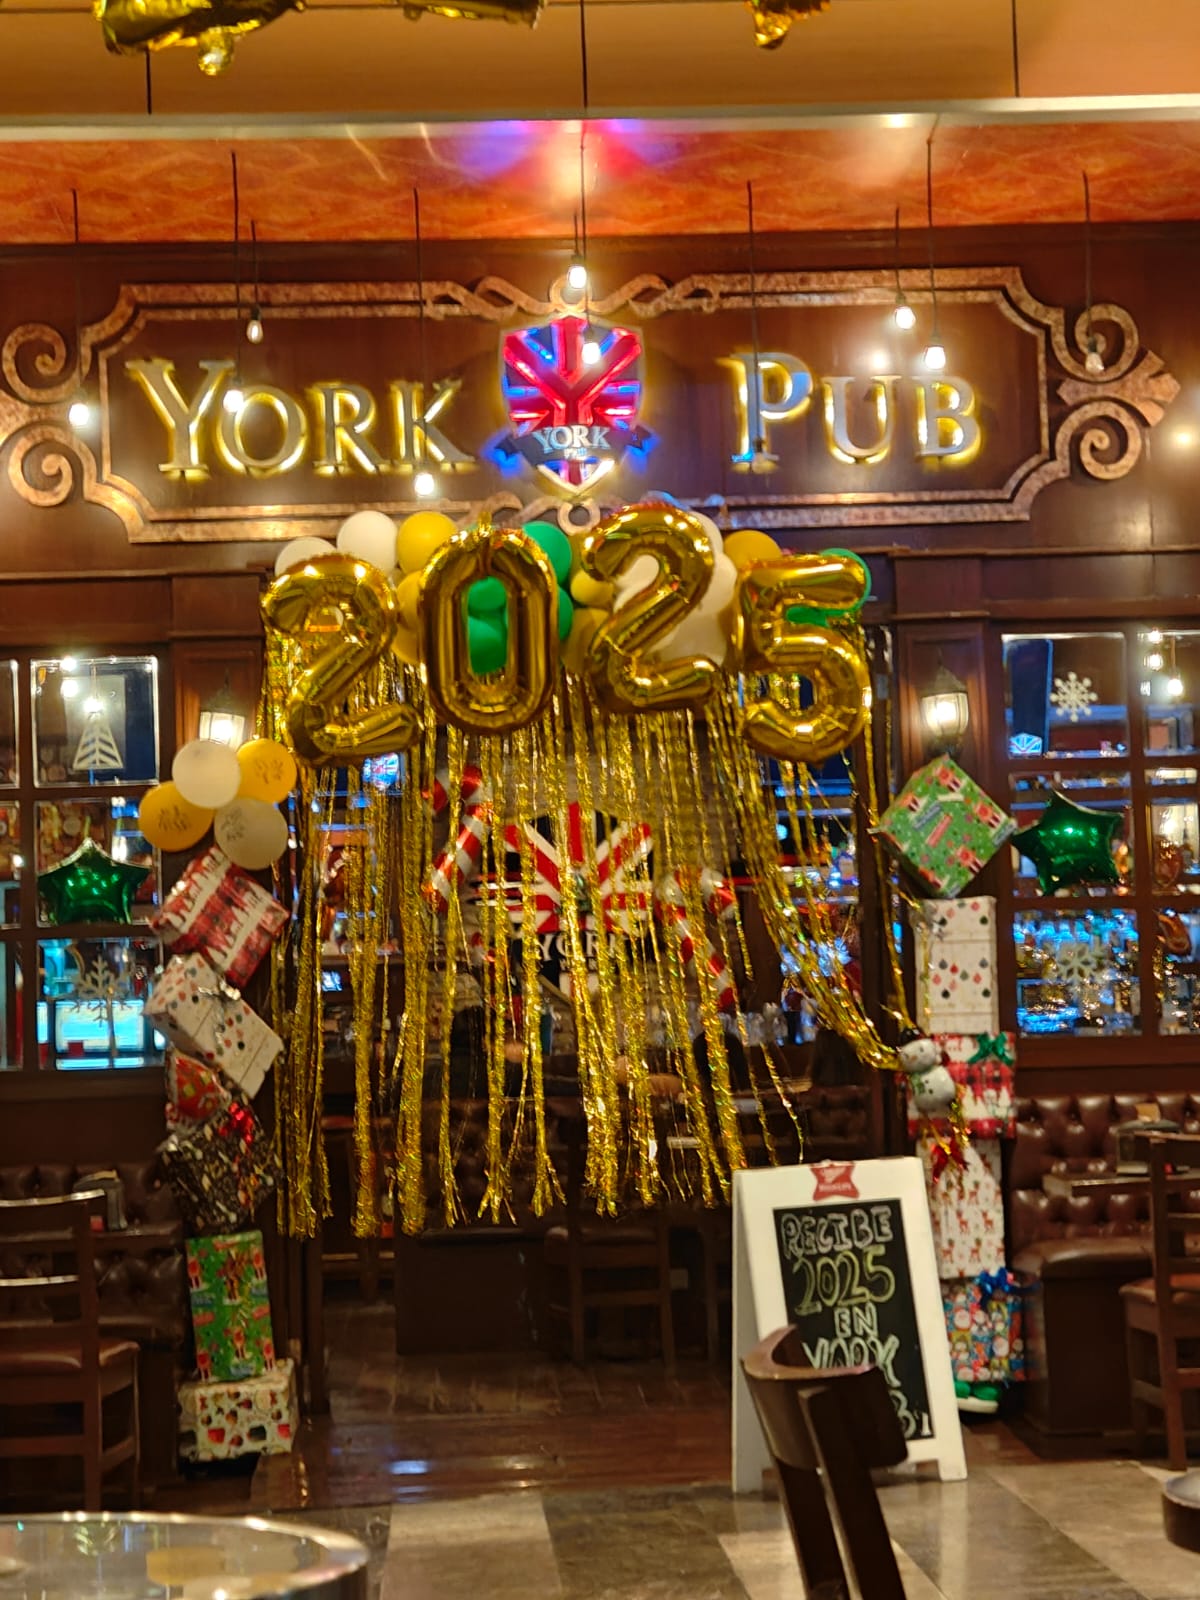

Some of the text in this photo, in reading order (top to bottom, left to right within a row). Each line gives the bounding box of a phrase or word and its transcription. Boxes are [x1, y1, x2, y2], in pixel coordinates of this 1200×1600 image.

[124, 350, 982, 476] YORK PUB
[532, 424, 612, 454] YORK
[260, 502, 874, 768] 2025
[780, 1205, 894, 1259] RECIBE
[792, 1245, 896, 1316] 2025
[834, 1301, 879, 1338] EN
